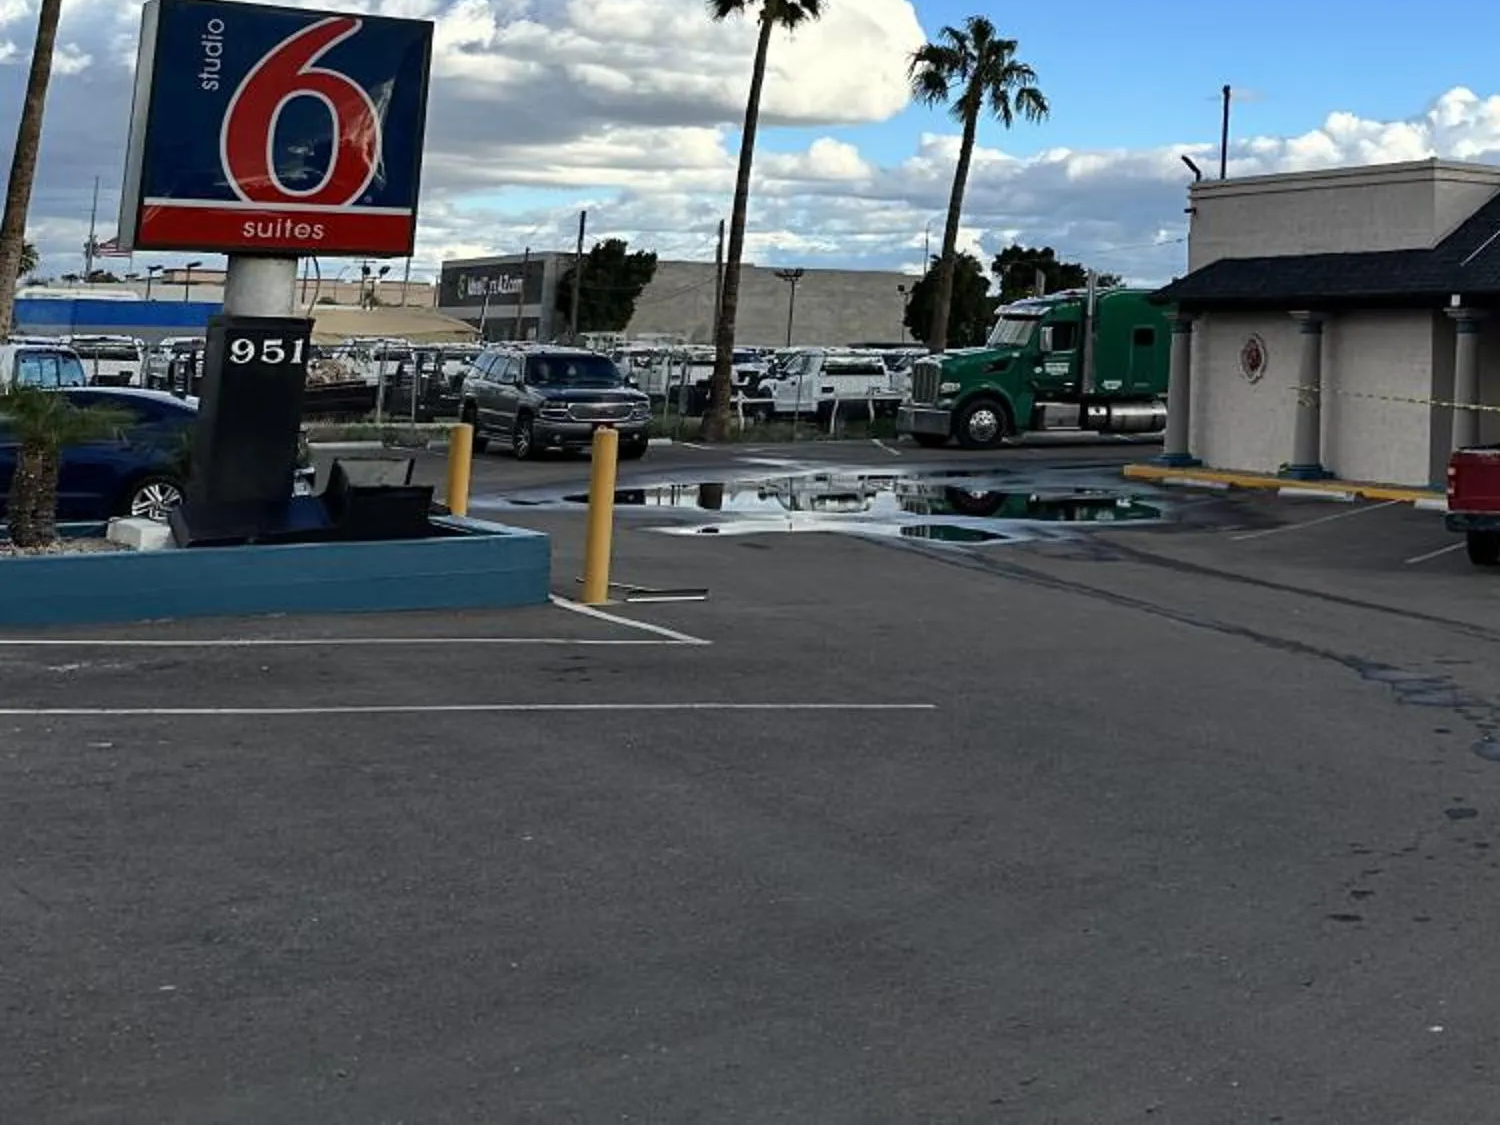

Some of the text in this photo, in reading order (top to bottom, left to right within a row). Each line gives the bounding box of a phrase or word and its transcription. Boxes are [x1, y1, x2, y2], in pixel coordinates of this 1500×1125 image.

[198, 18, 225, 92] studio
[220, 15, 382, 206] 6
[242, 219, 325, 241] suites
[229, 338, 304, 365] 951
